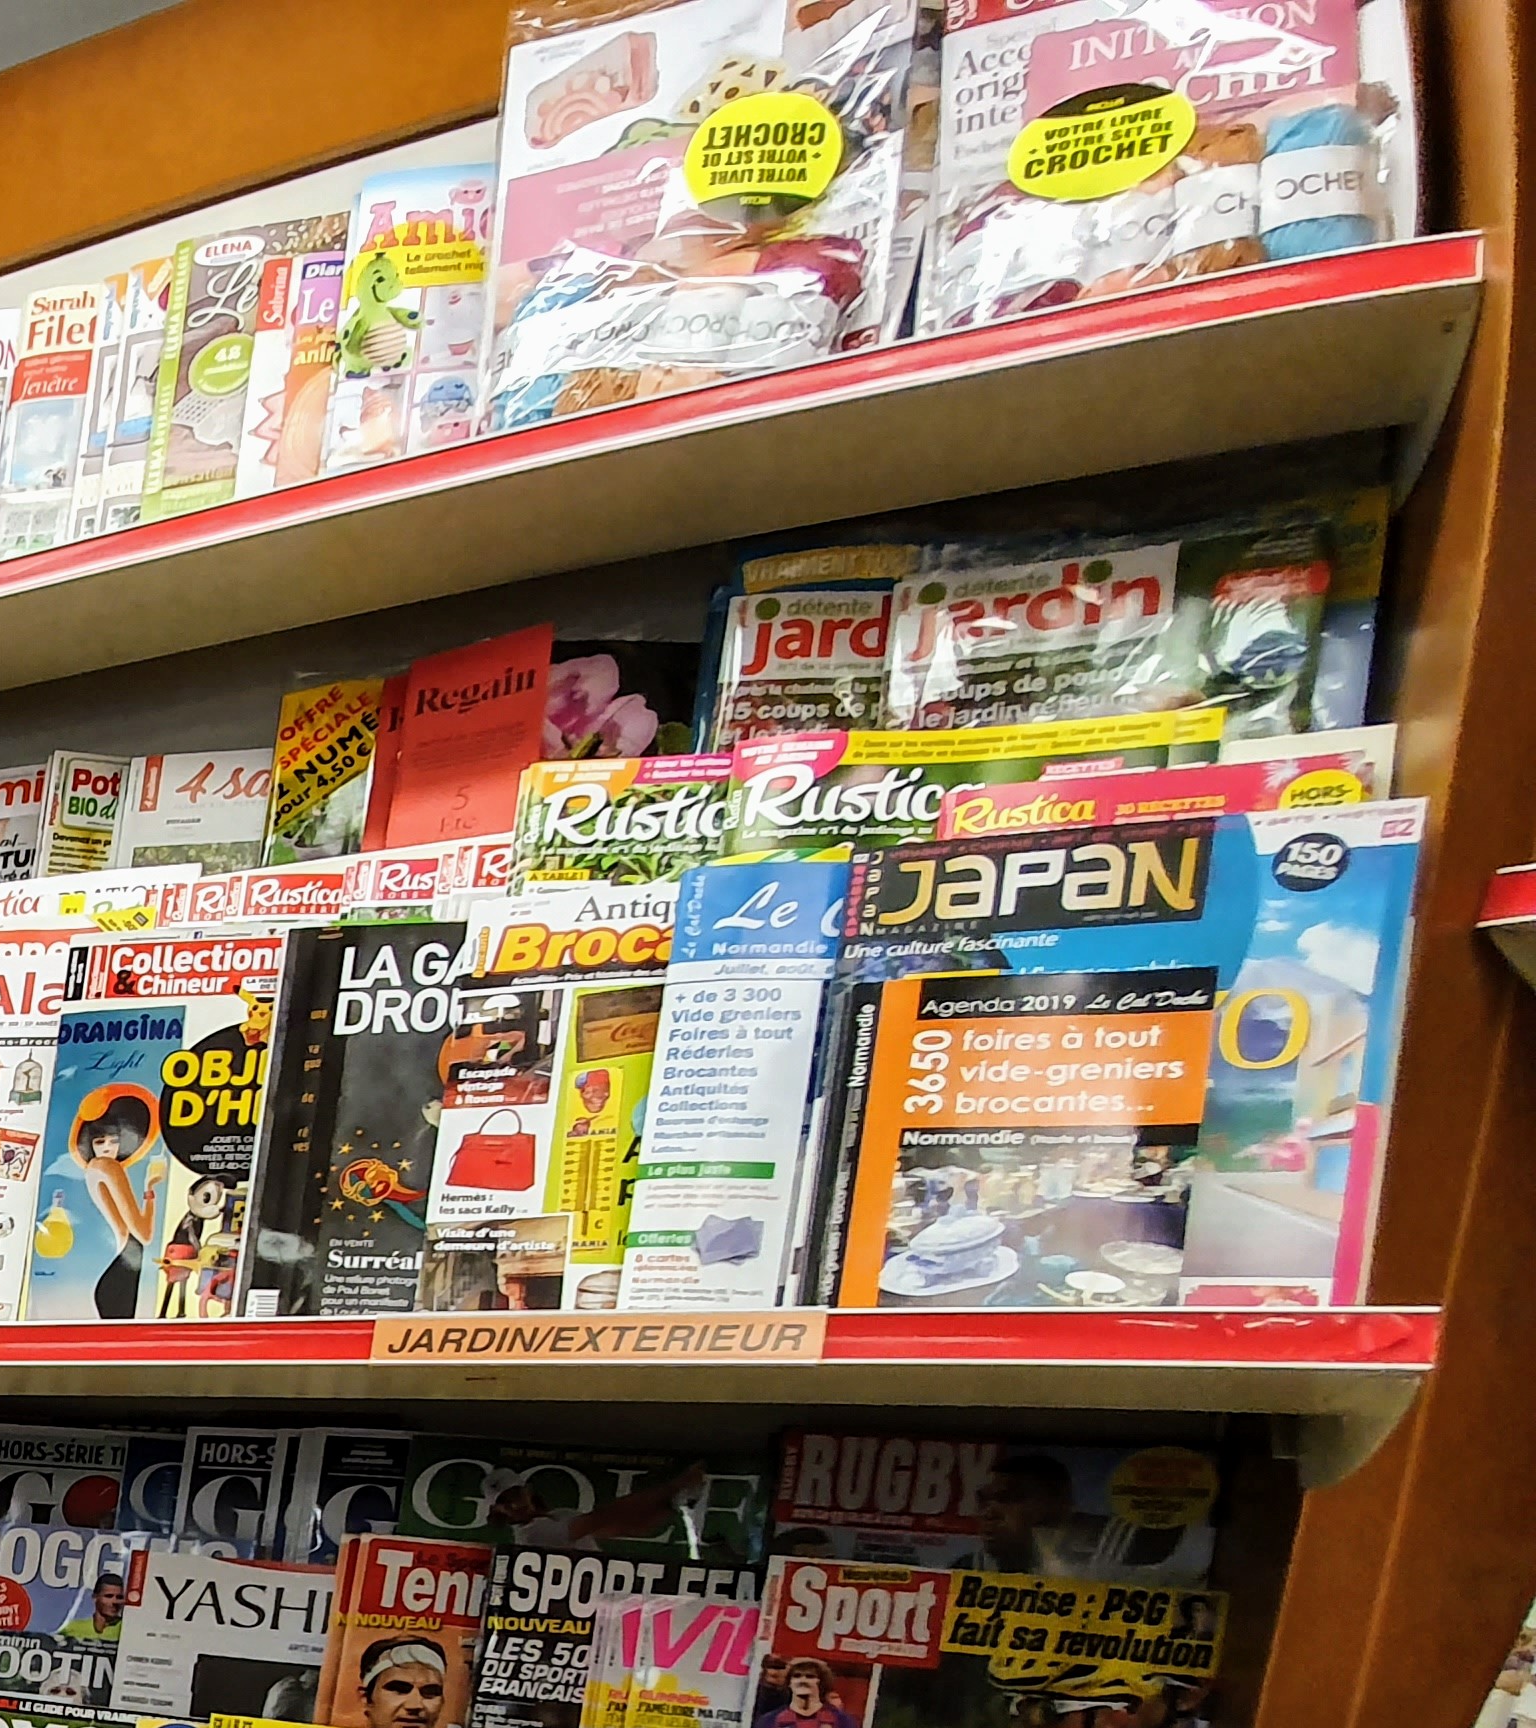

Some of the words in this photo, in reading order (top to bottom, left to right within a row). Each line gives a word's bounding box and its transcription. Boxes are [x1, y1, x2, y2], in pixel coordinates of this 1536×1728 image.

[706, 122, 826, 150] CROCHET
[1044, 117, 1106, 142] VOTRE
[1109, 106, 1165, 129] LIVRE
[1022, 133, 1172, 180] CROCHET
[203, 239, 254, 259] ELENA
[31, 292, 97, 317] Sarah
[262, 265, 291, 325] Sabrina
[785, 600, 873, 617] détente
[414, 666, 536, 716] Regain
[279, 685, 345, 743] OFFRE
[279, 691, 375, 772] SPÉCIALE
[951, 792, 1097, 837] Rustica
[1284, 840, 1344, 869] 150
[878, 836, 1199, 927] JAPAN
[711, 881, 799, 931] Le
[712, 941, 828, 956] Normandie
[843, 942, 884, 961] Une
[886, 937, 953, 957] culture
[956, 931, 1060, 952] fascinante
[340, 944, 404, 989] LA
[671, 1007, 714, 1023] Vide
[718, 1007, 802, 1025] greniers
[920, 996, 1016, 1017] Agenda
[1020, 993, 1077, 1011] 2019
[667, 1025, 729, 1042] Foires
[736, 1025, 748, 1039] à
[752, 1025, 793, 1041] tout
[848, 1002, 876, 1088] Normandie
[962, 1028, 1052, 1052] foires
[1061, 1024, 1084, 1049] à
[1093, 1023, 1162, 1049] tout
[84, 1050, 144, 1074] Light
[665, 1044, 755, 1060] Réderies
[457, 1066, 517, 1080] Escapade
[663, 1064, 759, 1079] Brocantes
[903, 1029, 954, 1115] 3650
[959, 1057, 1185, 1085] vide-greniers
[659, 1081, 749, 1096] Antiquités
[955, 1090, 1155, 1115] brocantes...
[657, 1098, 749, 1112] Collections
[902, 1128, 1025, 1146] Normandie
[432, 1240, 495, 1253] demeure
[497, 1239, 555, 1253] d'artiste
[435, 1226, 480, 1240] Visite
[483, 1227, 517, 1240] d'une
[387, 1323, 809, 1354] JARDIN/EXTERIEUR
[784, 1572, 939, 1651] Sport
[953, 1572, 1076, 1619] Reprise
[1103, 1584, 1173, 1624] PSG
[353, 1613, 442, 1632] NOUVEAU
[486, 1615, 593, 1636] NOUVEAU
[947, 1610, 999, 1651] fait
[1008, 1627, 1046, 1652] sa
[1053, 1618, 1214, 1672] révolution
